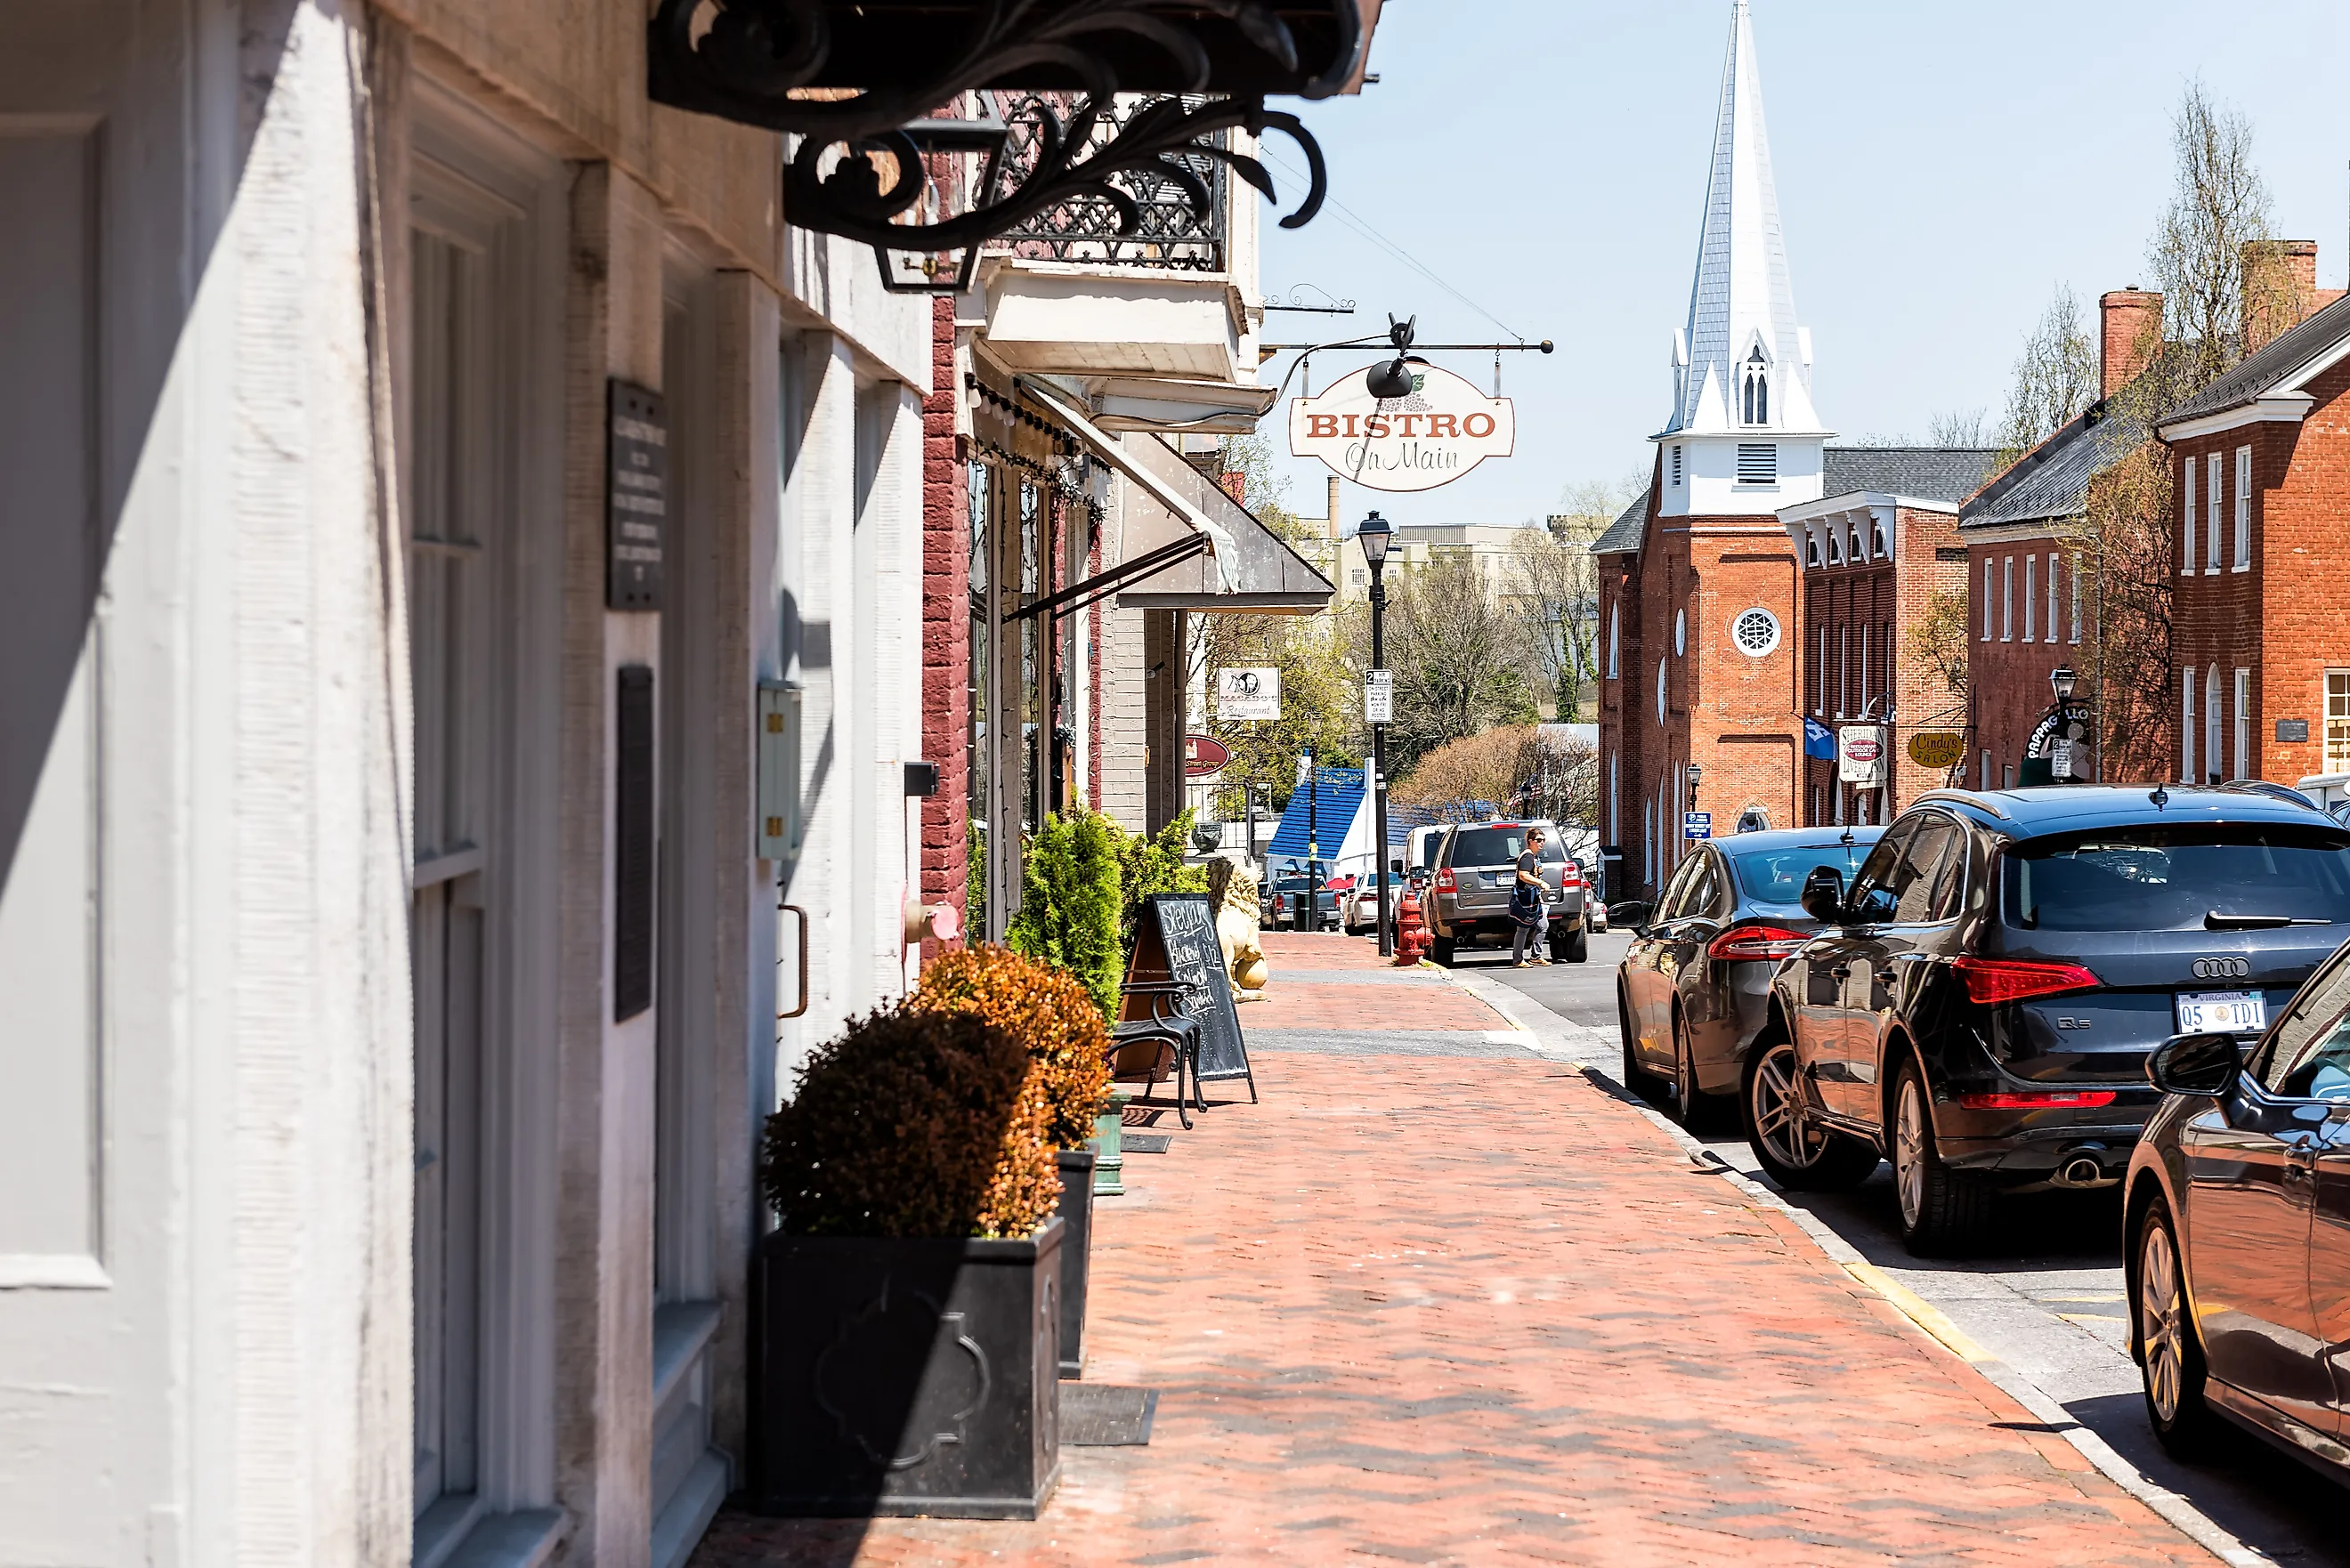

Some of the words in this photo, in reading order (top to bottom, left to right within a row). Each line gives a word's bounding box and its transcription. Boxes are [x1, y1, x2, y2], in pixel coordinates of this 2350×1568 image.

[1306, 413, 1495, 438] BISTRO
[1345, 442, 1380, 473] On
[1382, 441, 1459, 471] Main
[1366, 672, 1374, 683] 2
[1226, 705, 1271, 715] Restaurant
[1842, 728, 1885, 746] SHERIDAN
[2028, 708, 2089, 759] PAPPAGLLO
[1916, 733, 1957, 754] Cindy's
[1843, 756, 1866, 772] LIVERY
[1870, 755, 1885, 772] INN
[1916, 750, 1957, 763] SALON
[2199, 992, 2242, 1002] VIRGINIA
[2057, 1016, 2091, 1029] Q5
[2182, 1006, 2203, 1026] Q5
[2231, 1003, 2260, 1023] TDI
